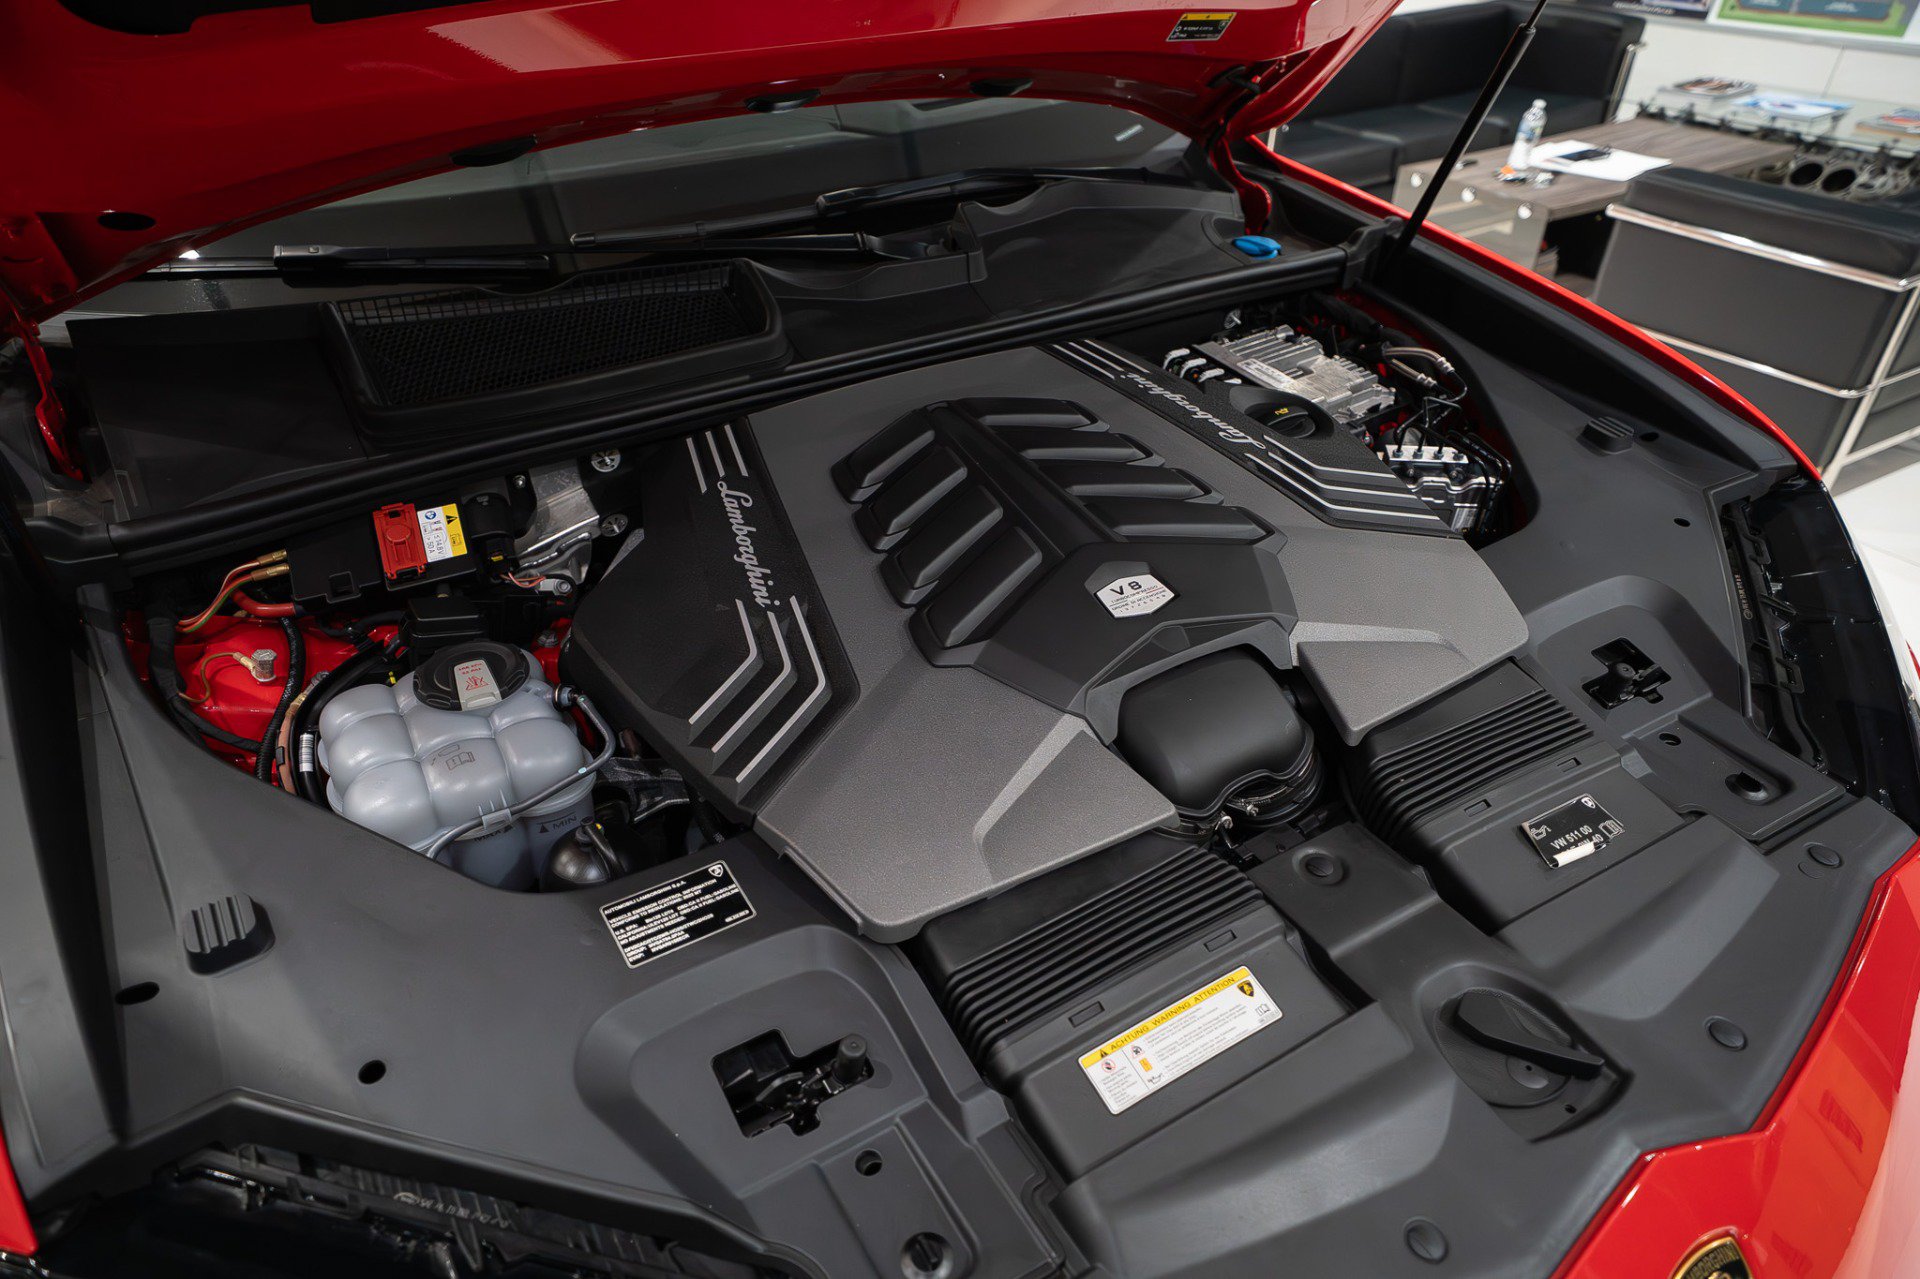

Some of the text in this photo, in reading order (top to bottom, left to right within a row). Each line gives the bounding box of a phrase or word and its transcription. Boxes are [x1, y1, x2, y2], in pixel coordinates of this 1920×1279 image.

[1120, 373, 1266, 449] Lamborghini
[717, 481, 780, 607] Lamborghini
[552, 815, 577, 830] MIN
[1550, 825, 1593, 850] VW 511 00
[604, 899, 636, 914] AUTOMOBILI
[636, 885, 672, 902] LAMBORGHINI
[608, 878, 717, 924] VEHICLE EMISSION CONTROL INFORMATION
[1110, 1026, 1149, 1050] ACHTUNG
[1153, 1002, 1191, 1026] WARNING
[1194, 977, 1235, 1004] ATTENTION
